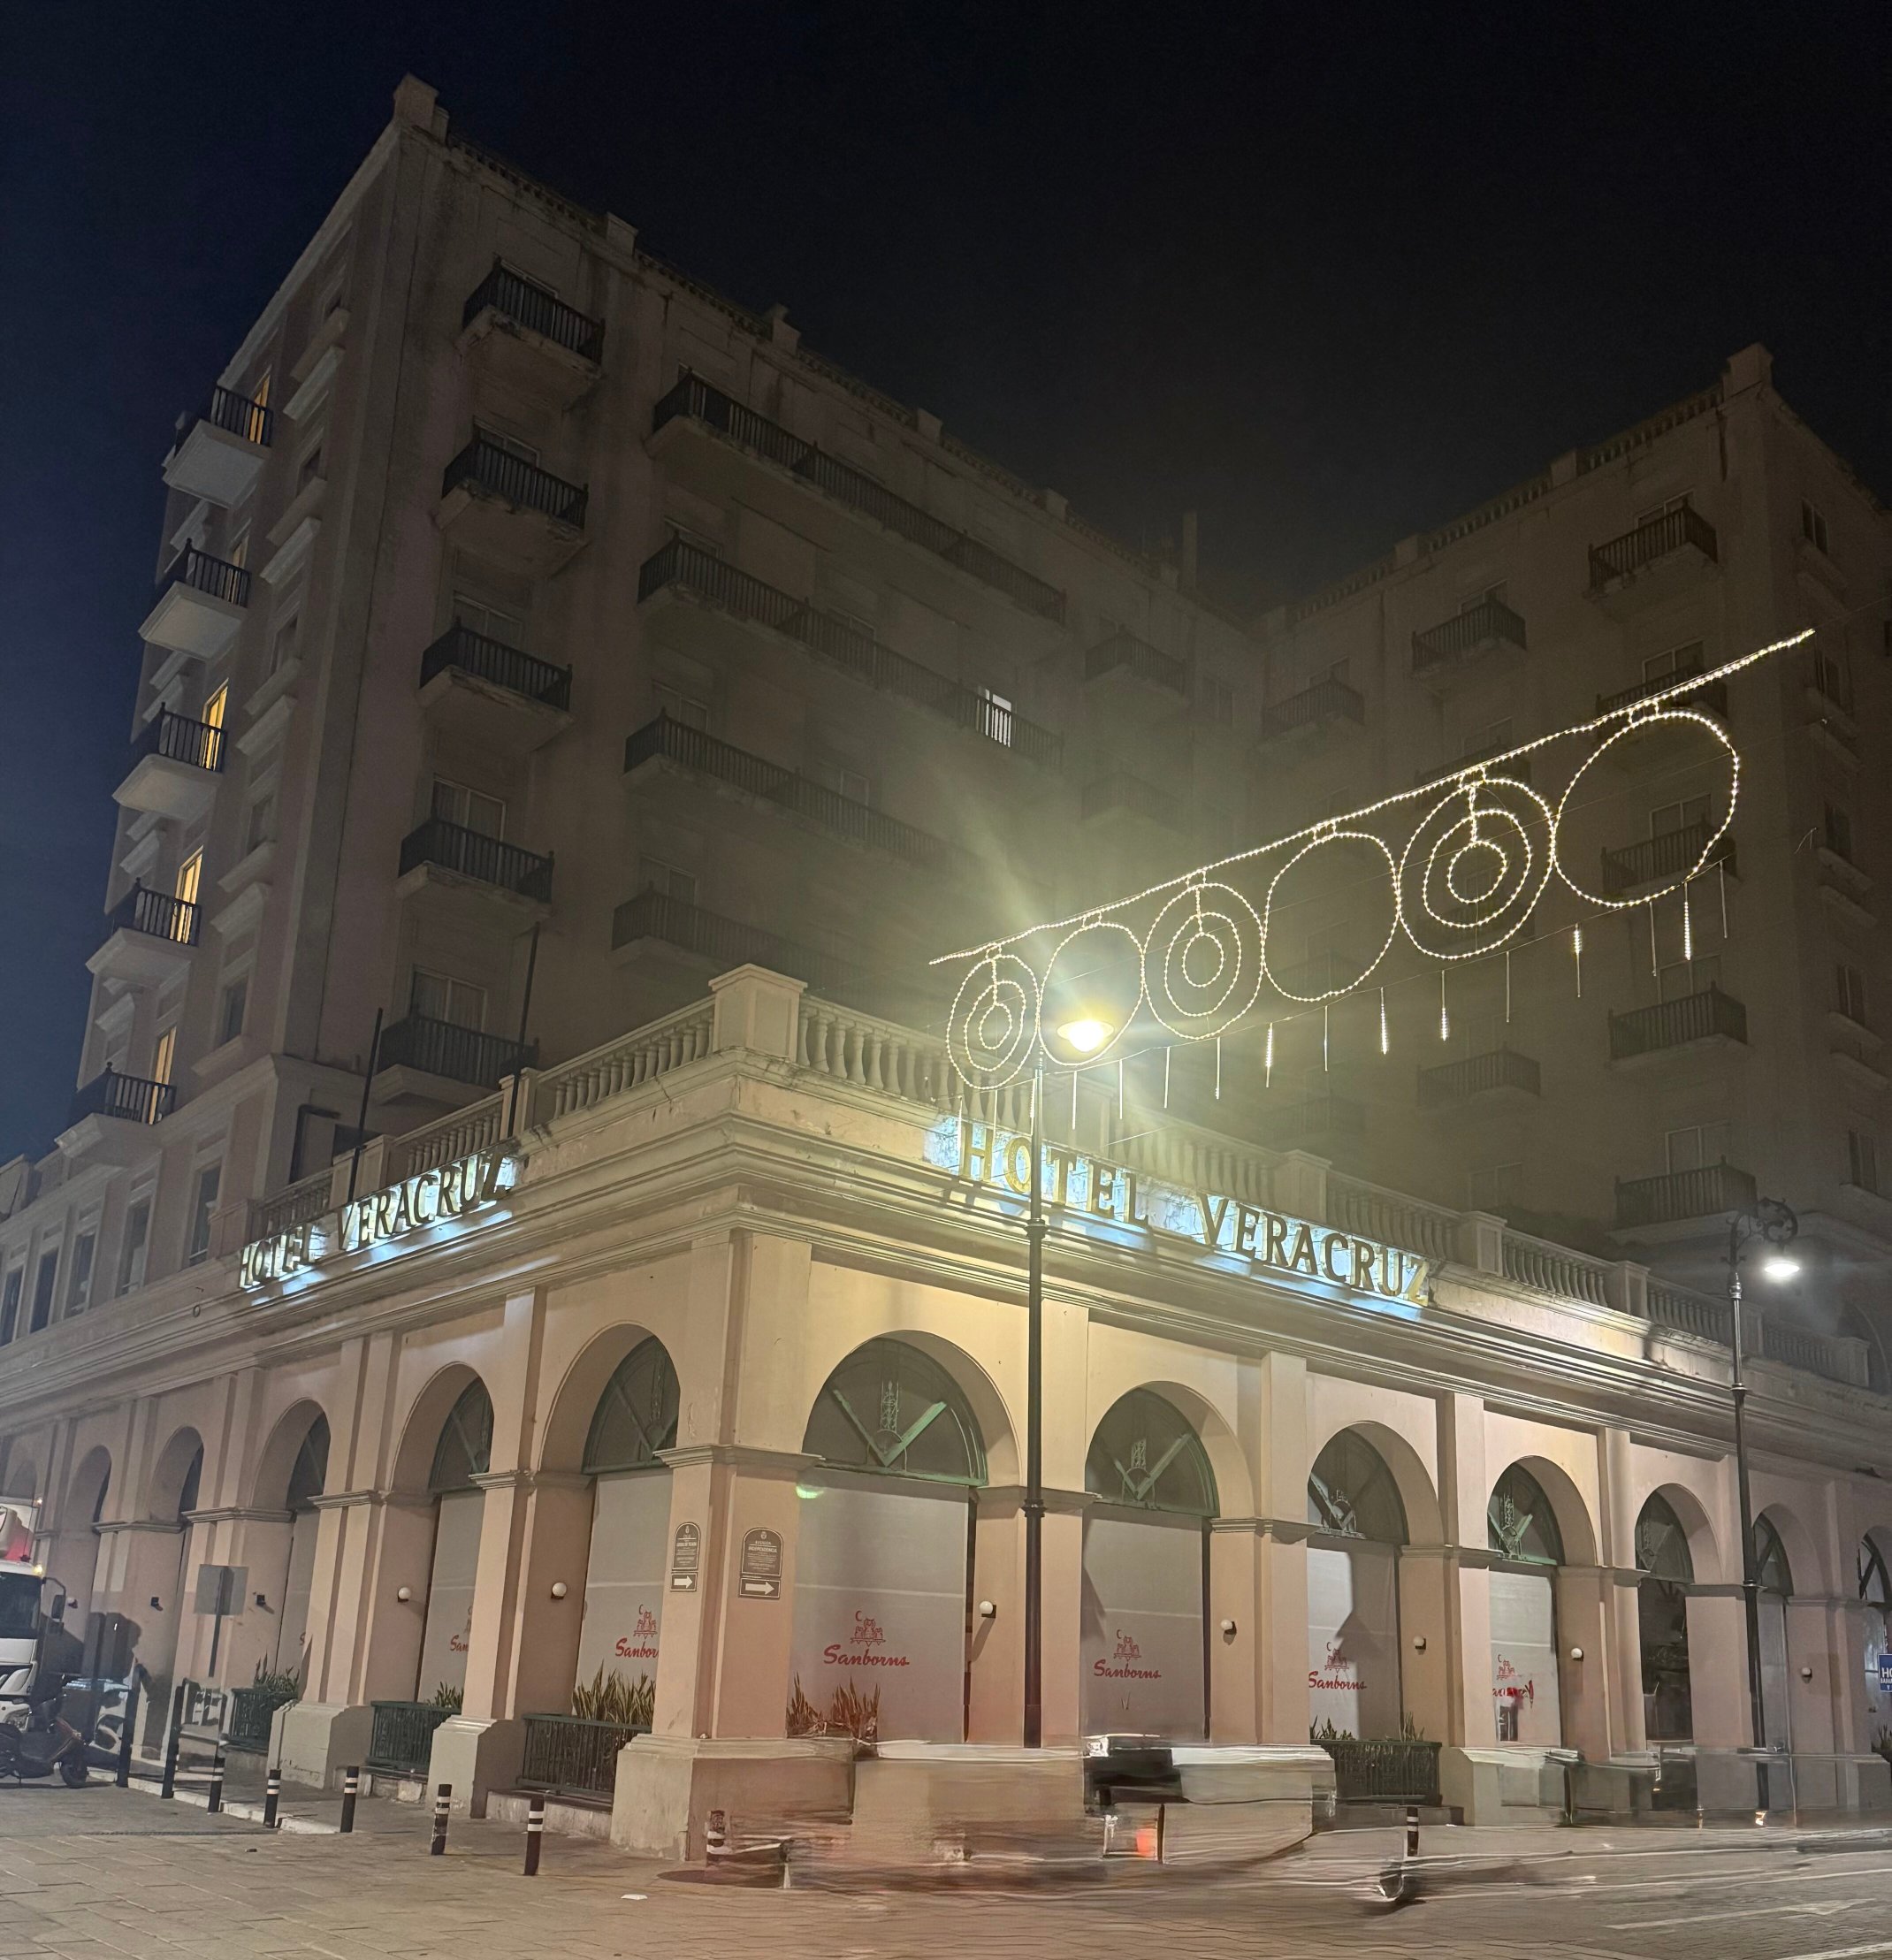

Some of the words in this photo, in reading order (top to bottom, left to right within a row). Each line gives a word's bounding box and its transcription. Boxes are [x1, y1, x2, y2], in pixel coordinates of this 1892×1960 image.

[239, 1223, 316, 1288] HOTEL
[338, 1148, 512, 1251] VERACRUZ
[958, 1119, 1149, 1227] HOTEL
[1196, 1194, 1430, 1307] VERACRUZ
[615, 1637, 660, 1658] Sanbor
[823, 1644, 910, 1666] Sanborns
[1094, 1659, 1162, 1679] Sanborns
[1308, 1671, 1367, 1689] Sanborns
